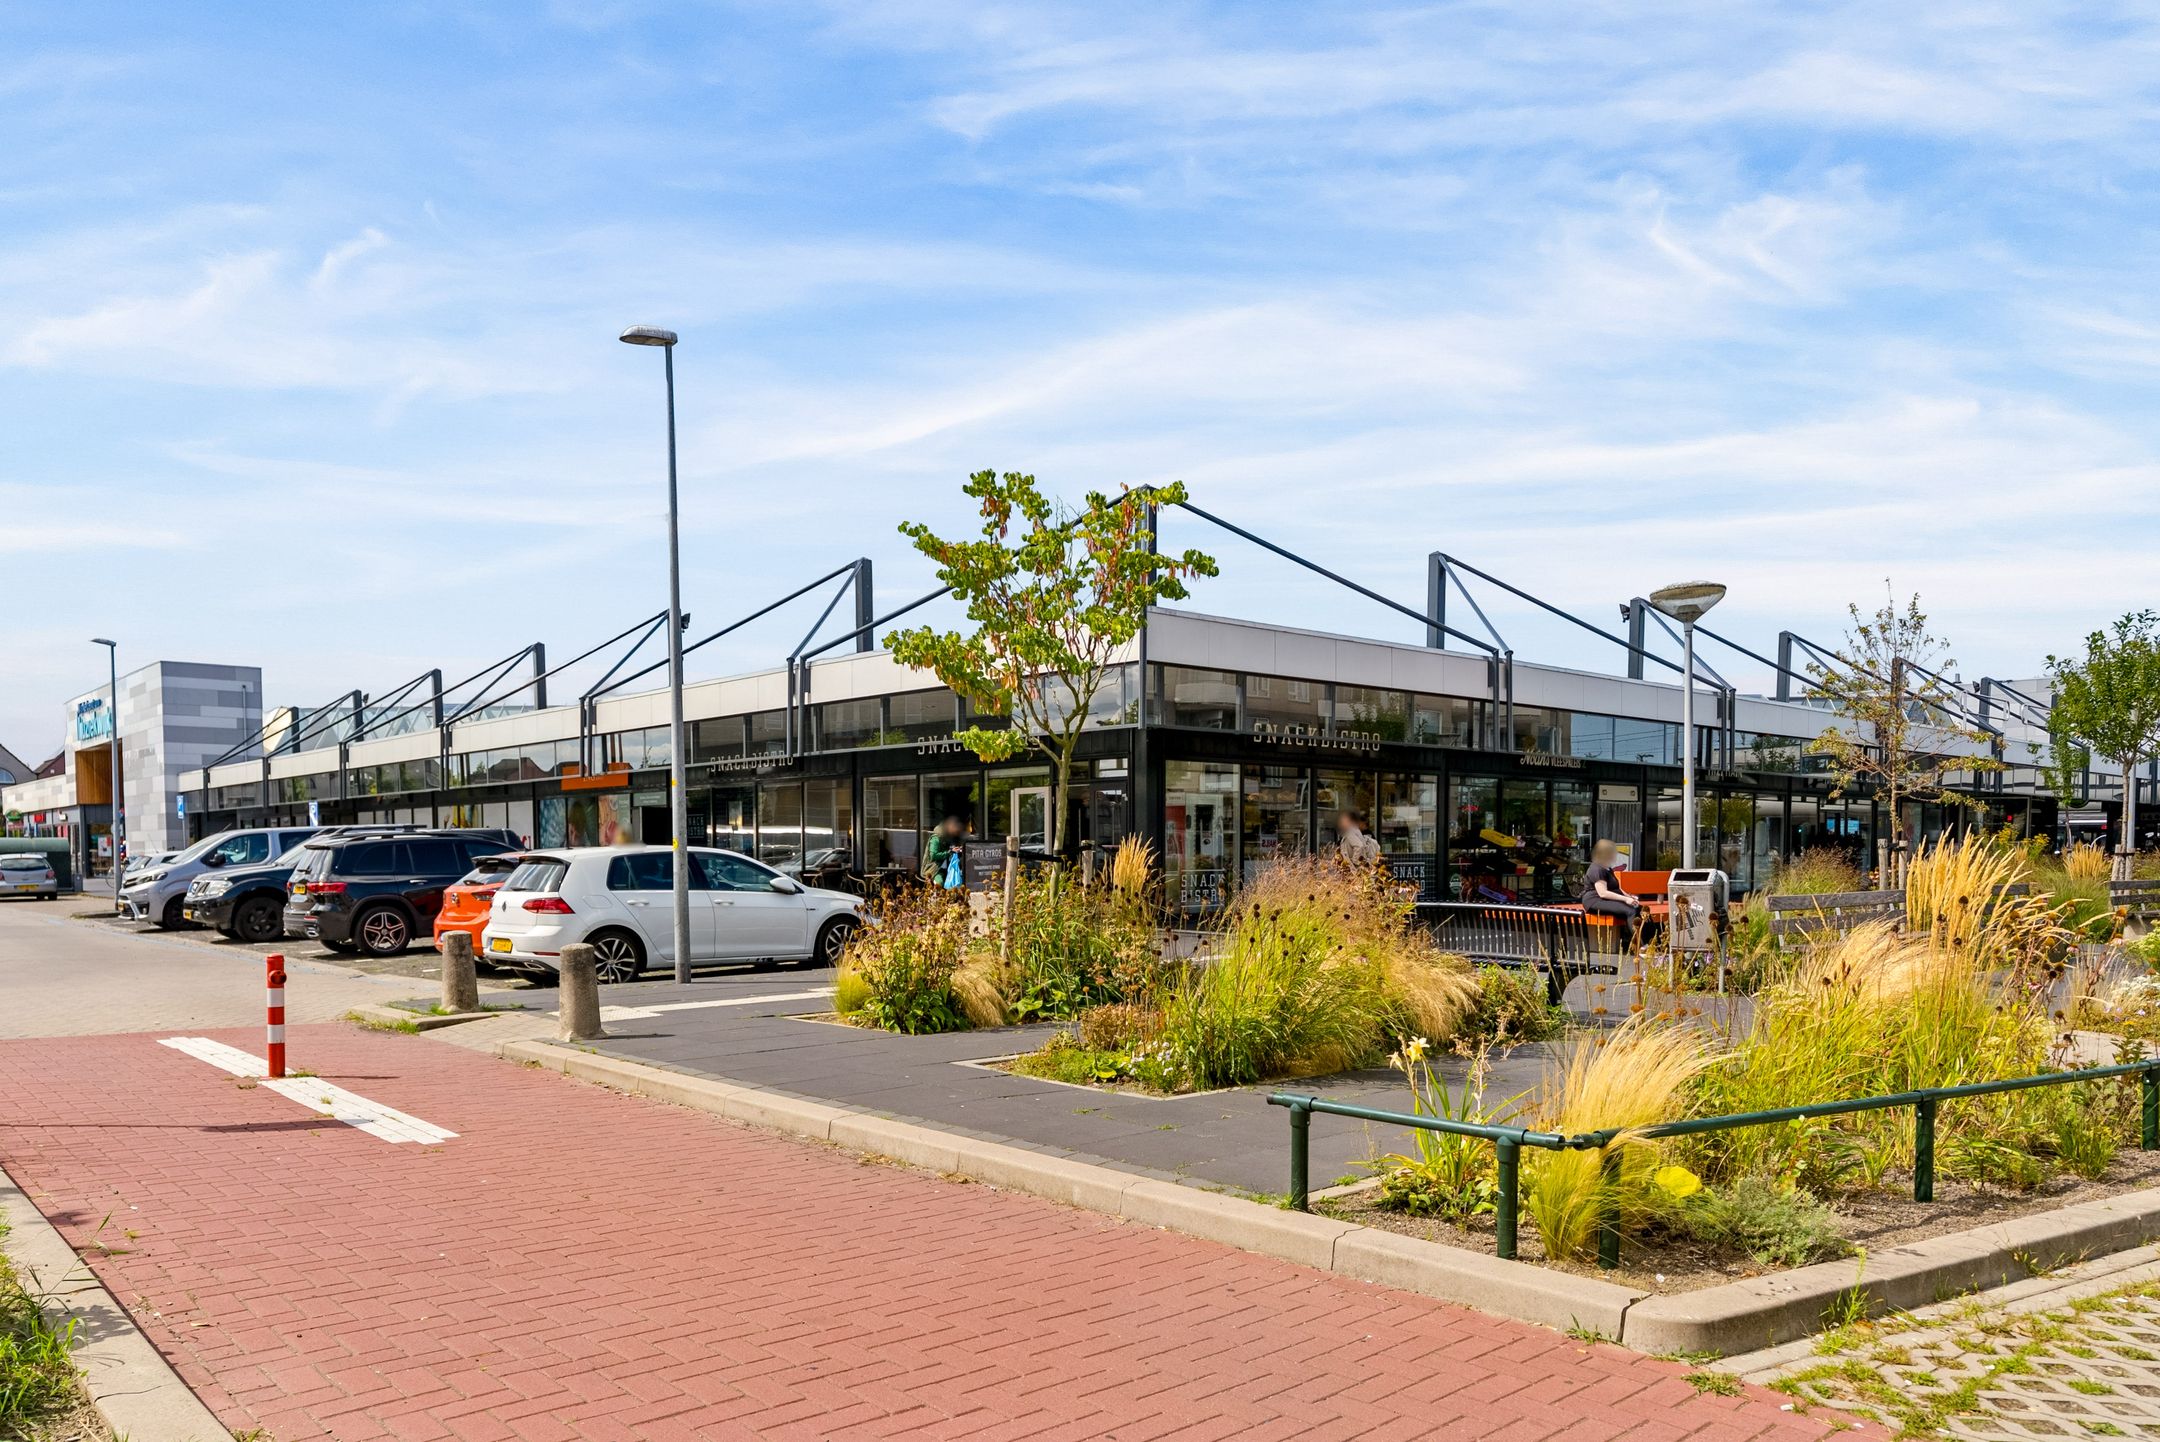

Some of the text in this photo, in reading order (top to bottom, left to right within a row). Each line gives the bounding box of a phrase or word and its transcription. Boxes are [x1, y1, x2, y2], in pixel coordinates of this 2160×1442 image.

[1254, 722, 1380, 751] SNACKBISTRO
[1393, 866, 1425, 879] SNACK
[1181, 873, 1226, 888] SNACK
